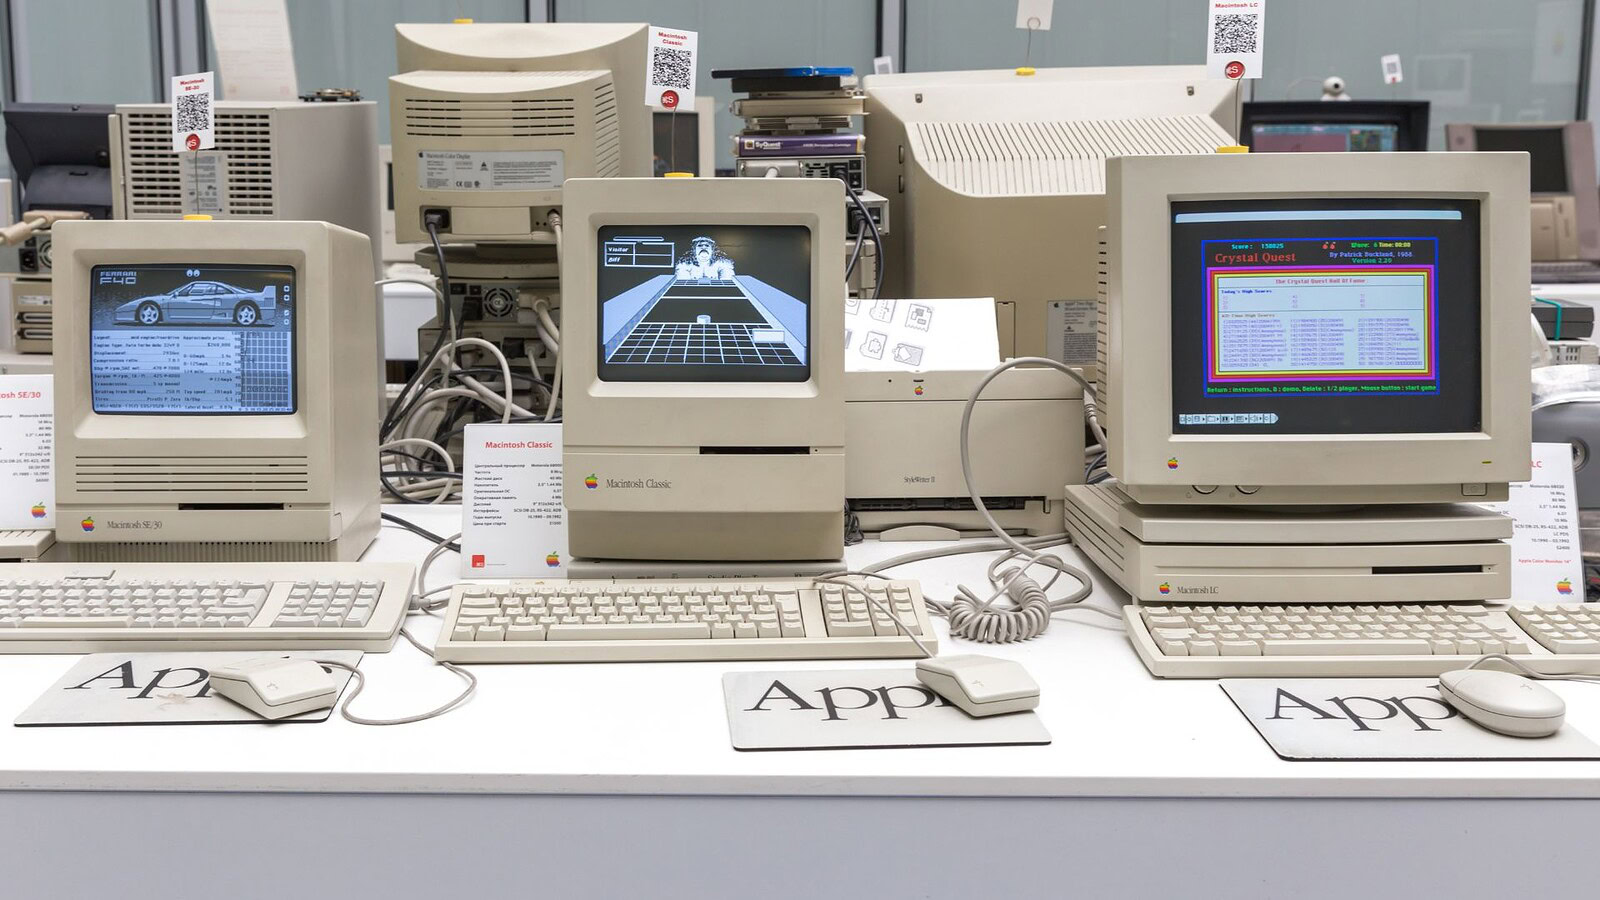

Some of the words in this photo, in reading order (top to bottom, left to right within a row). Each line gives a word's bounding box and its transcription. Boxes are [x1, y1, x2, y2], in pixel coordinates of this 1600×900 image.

[658, 31, 687, 40] Macintosh
[180, 78, 204, 86] Macintosh
[755, 141, 781, 149] SyQuest
[1215, 253, 1258, 264] Crystal
[1262, 252, 1296, 264] Quest
[99, 276, 137, 285] F40
[17, 391, 41, 399] SE/30
[485, 441, 526, 449] Macintosh
[526, 441, 553, 449] Classic
[1531, 460, 1542, 468] LC
[606, 479, 644, 489] Macintosh
[646, 479, 672, 489] Classic
[903, 475, 930, 485] StyleWriter
[106, 520, 141, 529] Macintosh
[142, 520, 163, 530] SE/30
[1176, 586, 1209, 594] Macintosh
[1209, 586, 1219, 594] LC
